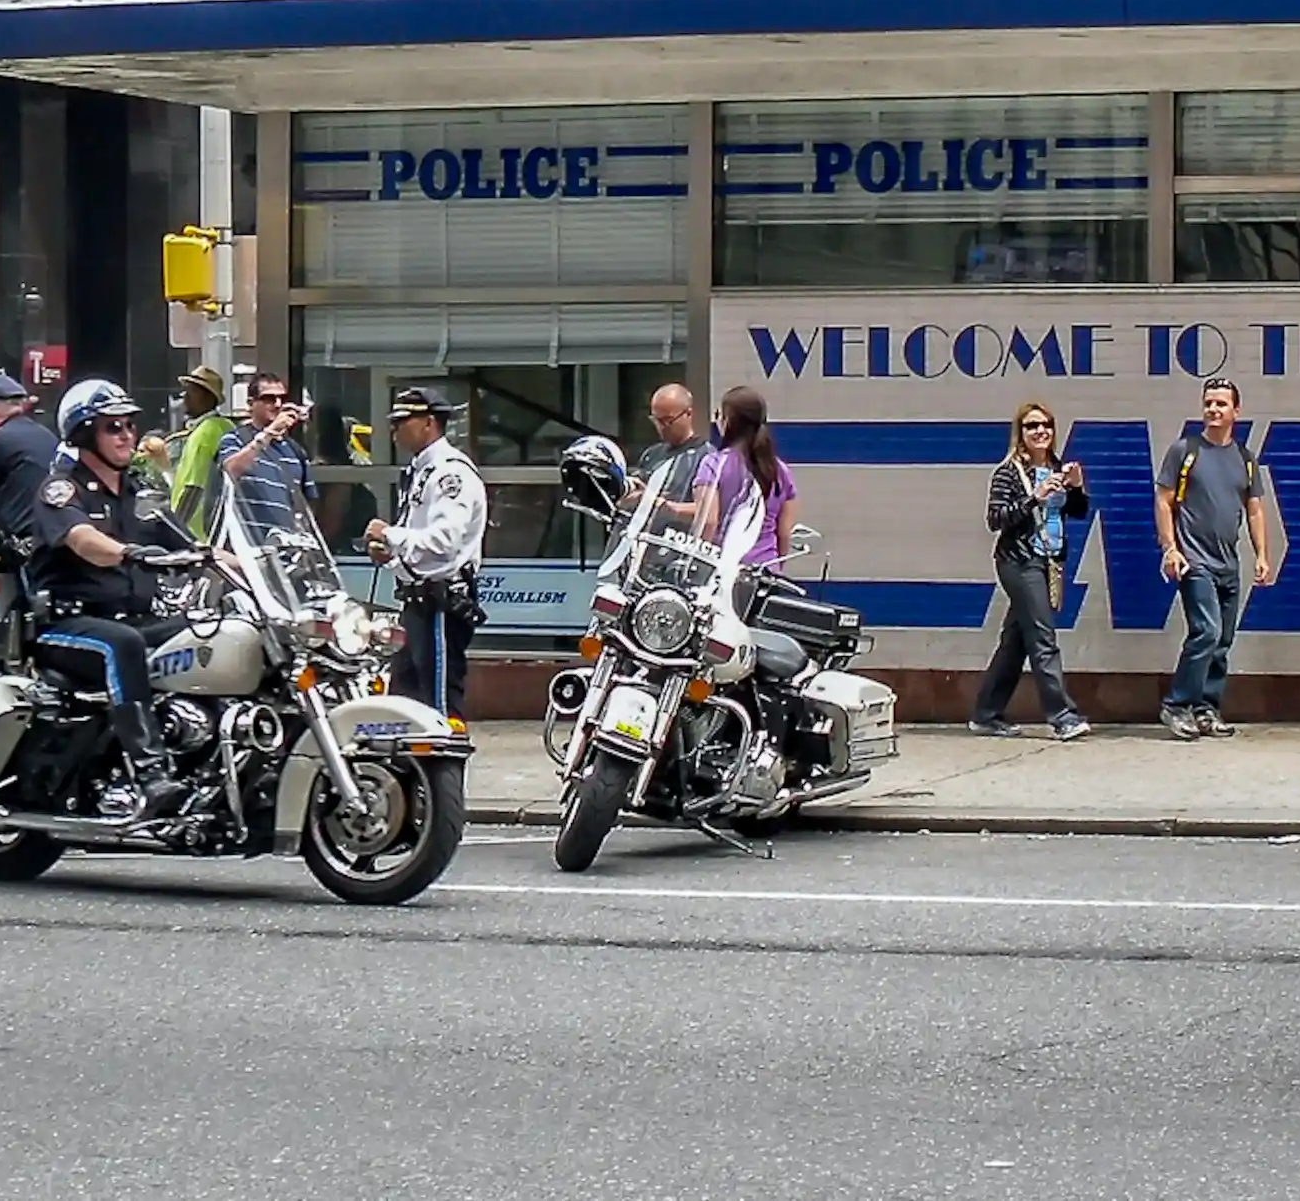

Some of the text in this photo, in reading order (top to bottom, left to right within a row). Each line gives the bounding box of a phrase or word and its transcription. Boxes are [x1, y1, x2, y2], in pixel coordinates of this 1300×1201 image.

[379, 146, 601, 199] POLICE
[812, 137, 1048, 193] POLICE
[749, 322, 1114, 380] WELCOME
[1135, 322, 1229, 377] TO
[479, 591, 567, 604] SIONALISM
